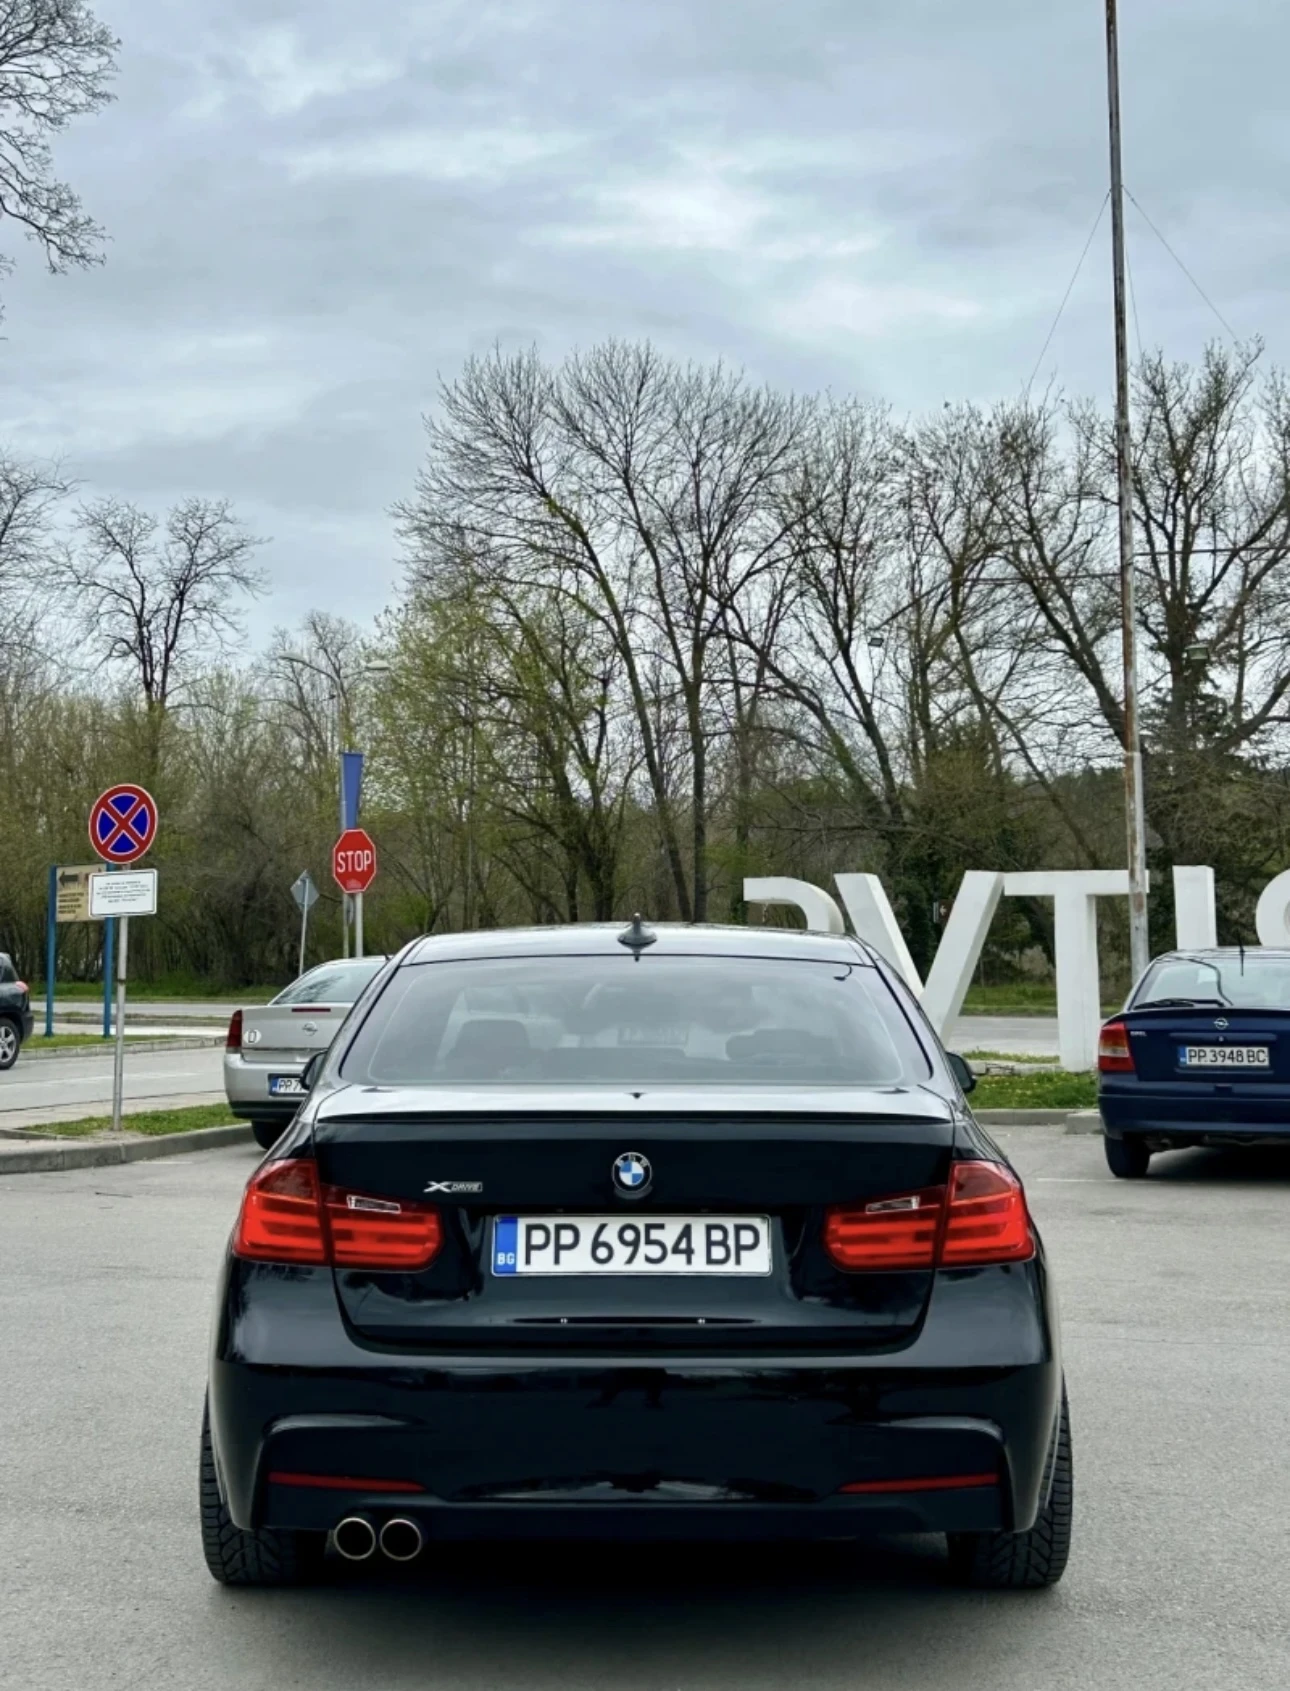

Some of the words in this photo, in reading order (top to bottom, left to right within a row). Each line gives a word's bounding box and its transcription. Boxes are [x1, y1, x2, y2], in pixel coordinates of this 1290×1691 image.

[337, 850, 372, 872] STOP
[1210, 1049, 1243, 1063] 3948
[1247, 1049, 1266, 1063] BC
[525, 1223, 580, 1266] PP
[590, 1223, 695, 1266] 6954
[705, 1223, 760, 1266] BP
[497, 1252, 515, 1265] BG
